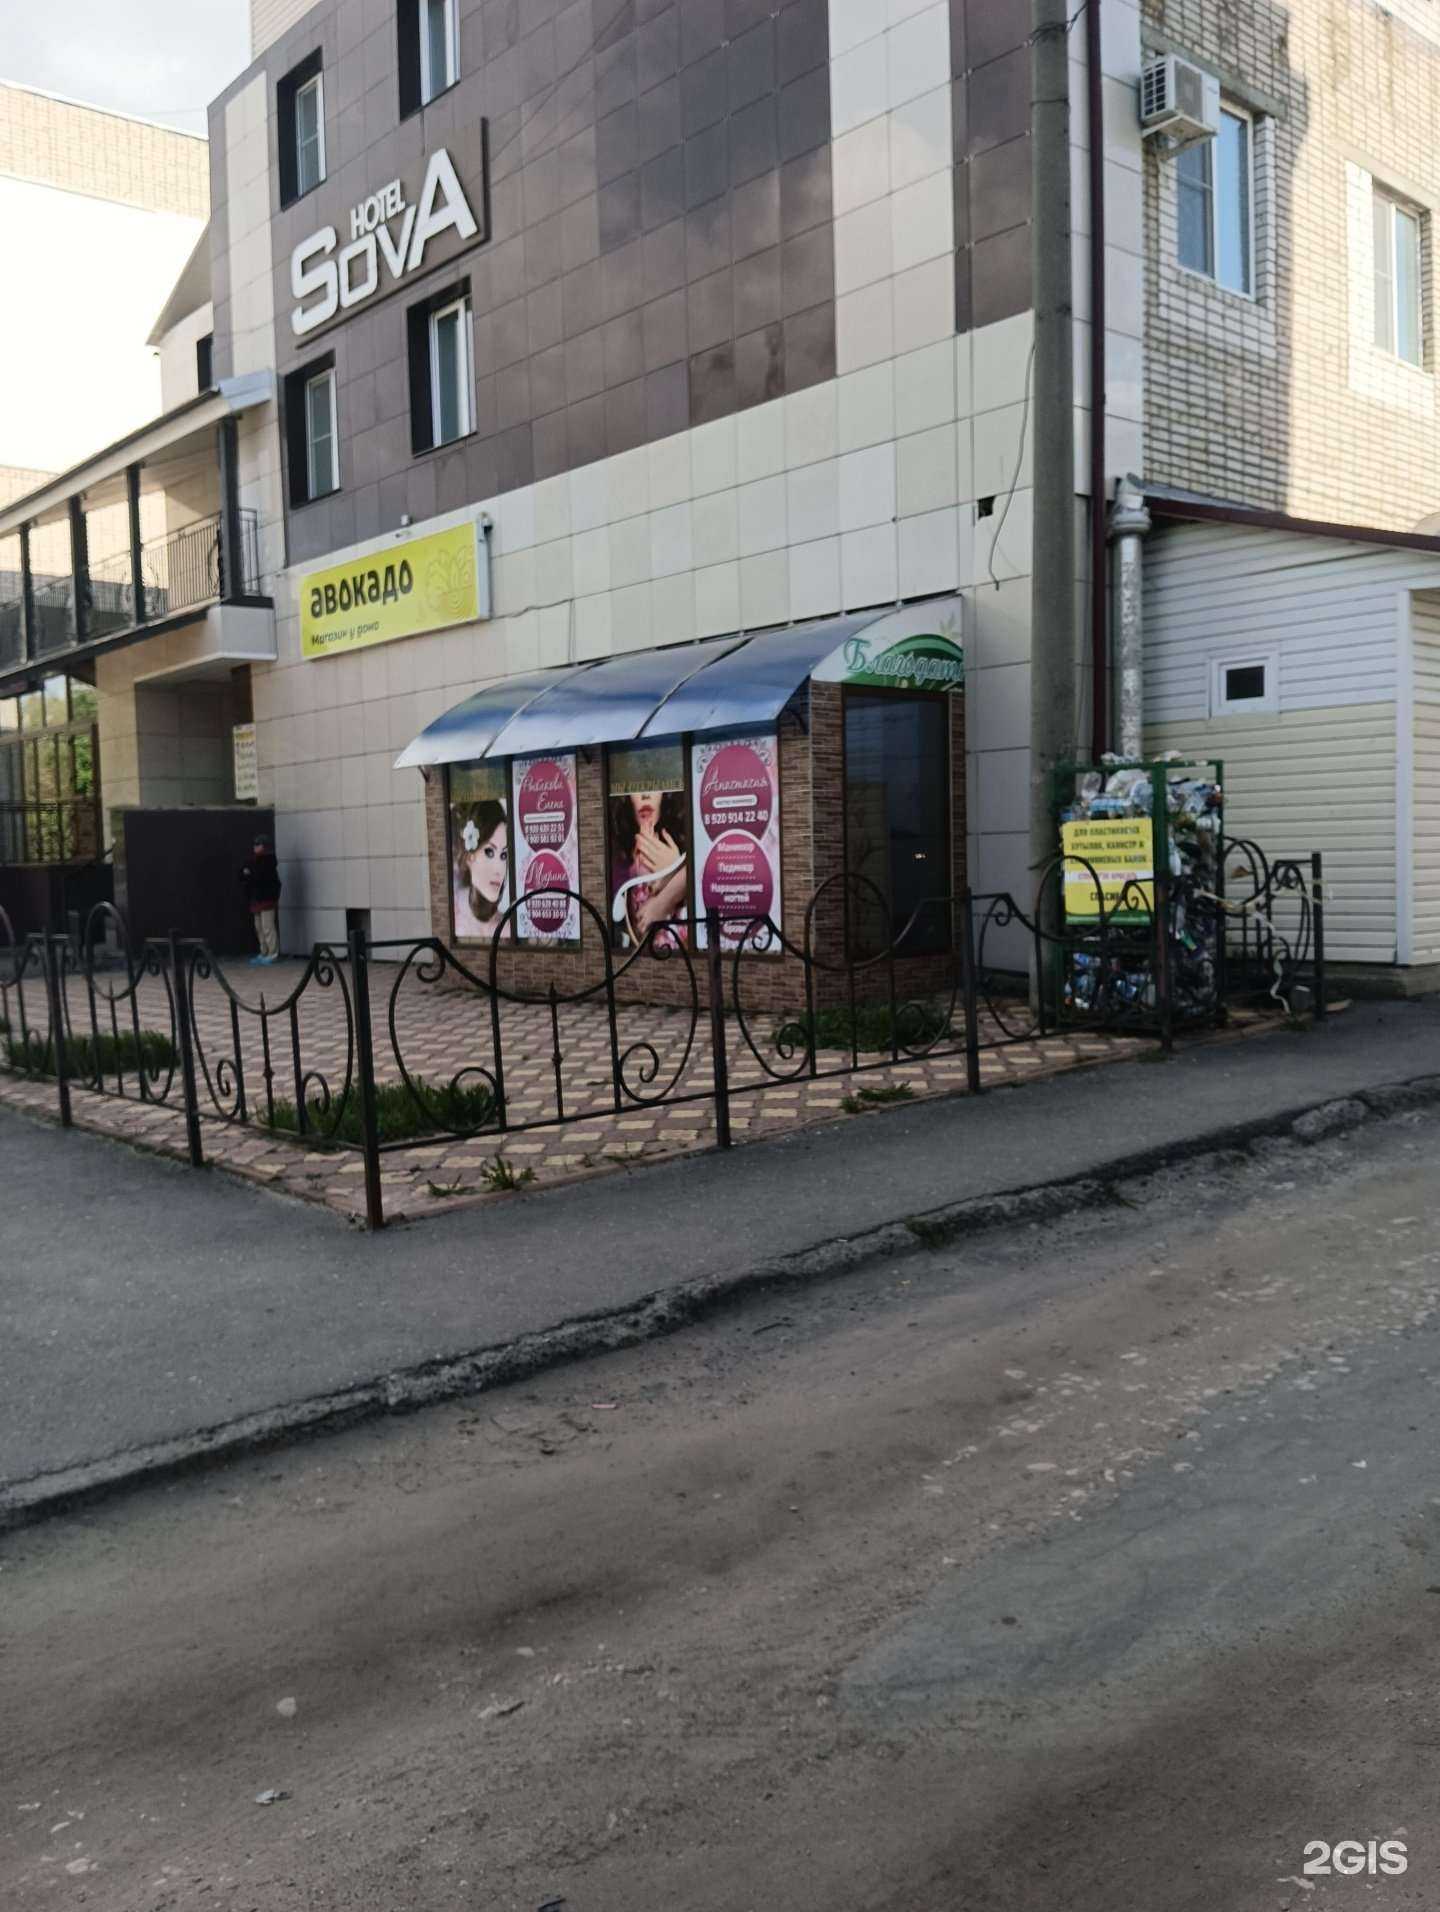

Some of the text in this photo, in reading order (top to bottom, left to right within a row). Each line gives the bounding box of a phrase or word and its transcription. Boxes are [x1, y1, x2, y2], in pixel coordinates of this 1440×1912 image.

[351, 178, 405, 240] HOTEL
[291, 148, 478, 335] SOVA
[311, 559, 413, 619] авокадо
[745, 810, 756, 822] 22
